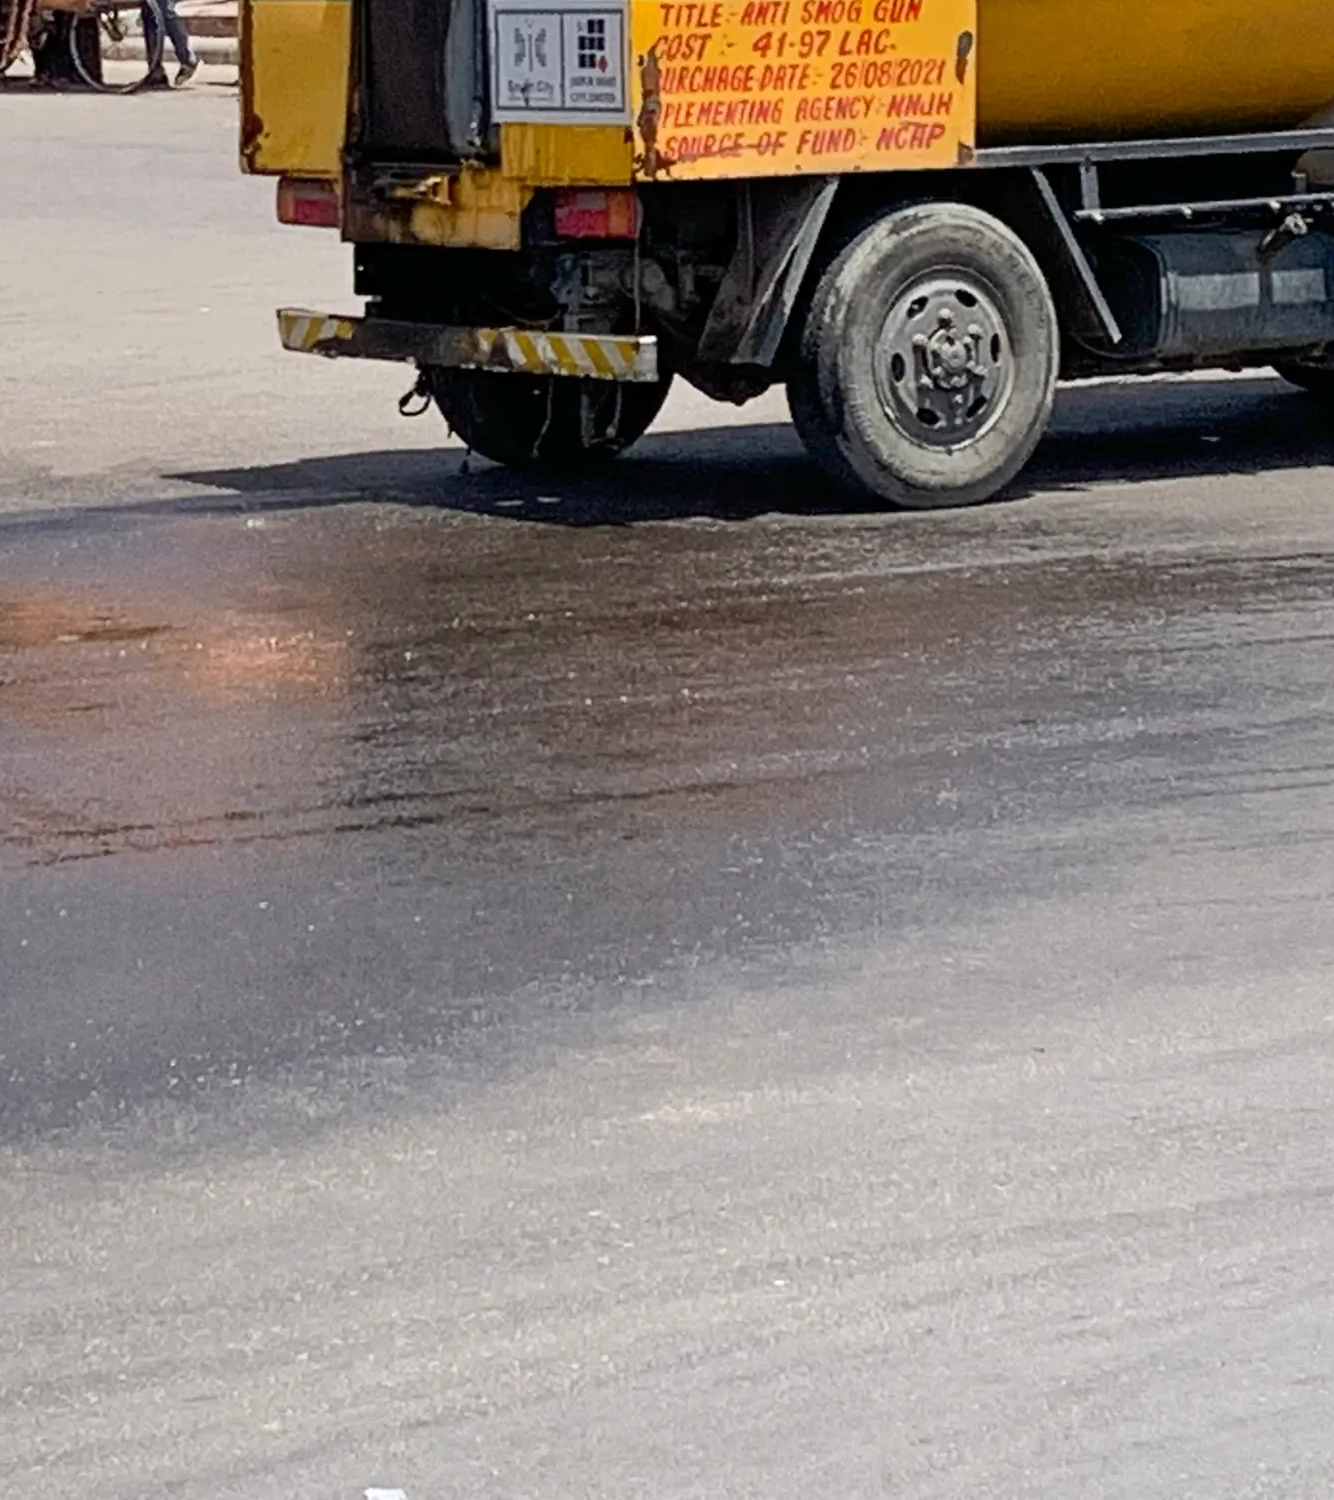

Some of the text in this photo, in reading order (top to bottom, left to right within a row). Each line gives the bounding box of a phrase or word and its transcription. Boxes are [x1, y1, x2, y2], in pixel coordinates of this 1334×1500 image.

[654, 31, 713, 62] COST
[661, 64, 756, 94] URCHAGE
[661, 97, 785, 129] PLEMENTING
[664, 131, 746, 159] SOURCE
[756, 131, 788, 157] OF
[875, 121, 946, 151] NCAP
